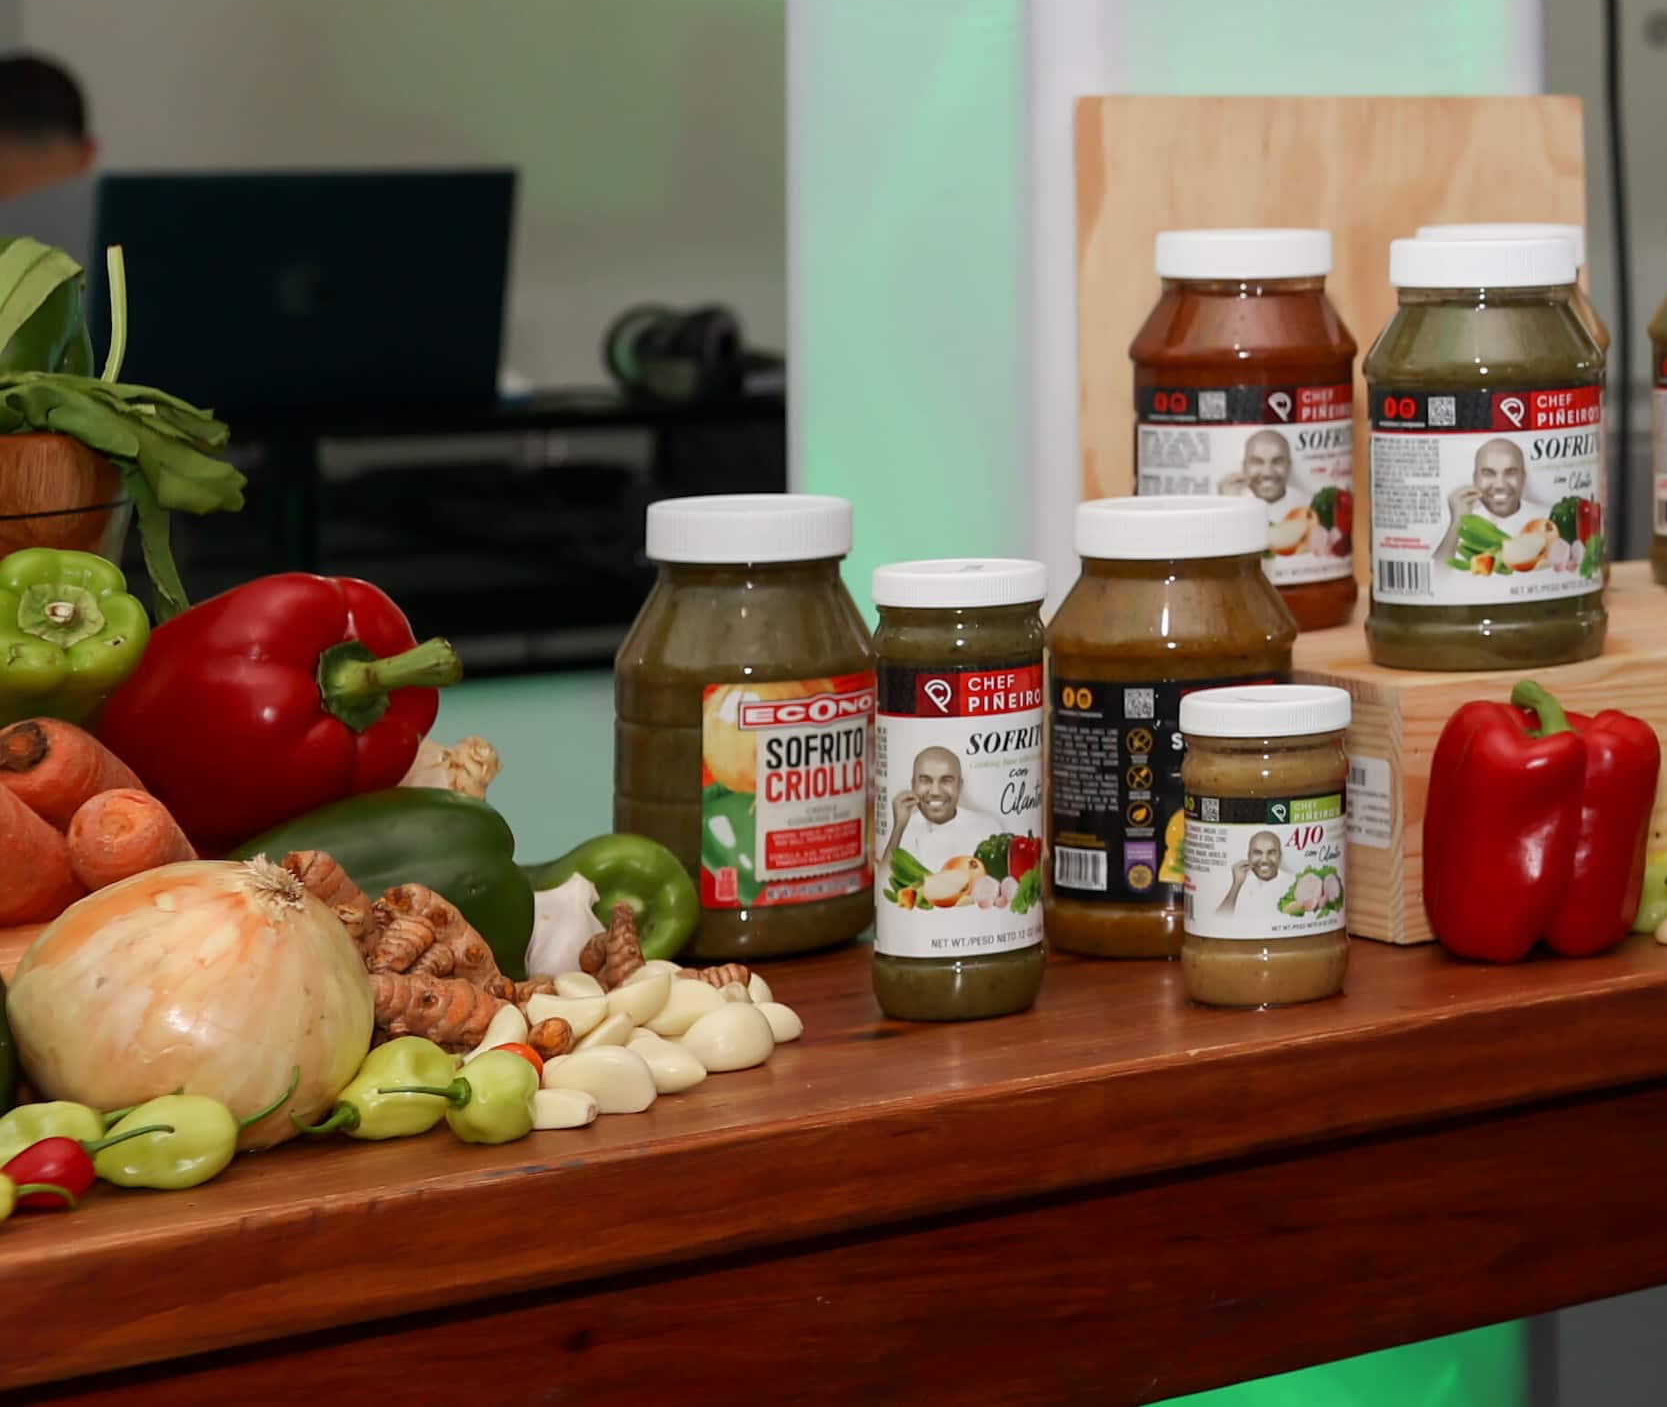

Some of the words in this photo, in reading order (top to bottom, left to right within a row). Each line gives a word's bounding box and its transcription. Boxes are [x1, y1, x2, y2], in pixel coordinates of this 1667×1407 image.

[1537, 394, 1573, 408] CHEF
[968, 674, 1015, 692] CHEF
[745, 696, 873, 724] ECONO
[766, 727, 864, 770] SOFRITO
[765, 759, 864, 803] CRIOLLO
[1009, 767, 1029, 778] con
[1286, 825, 1324, 850] AJO
